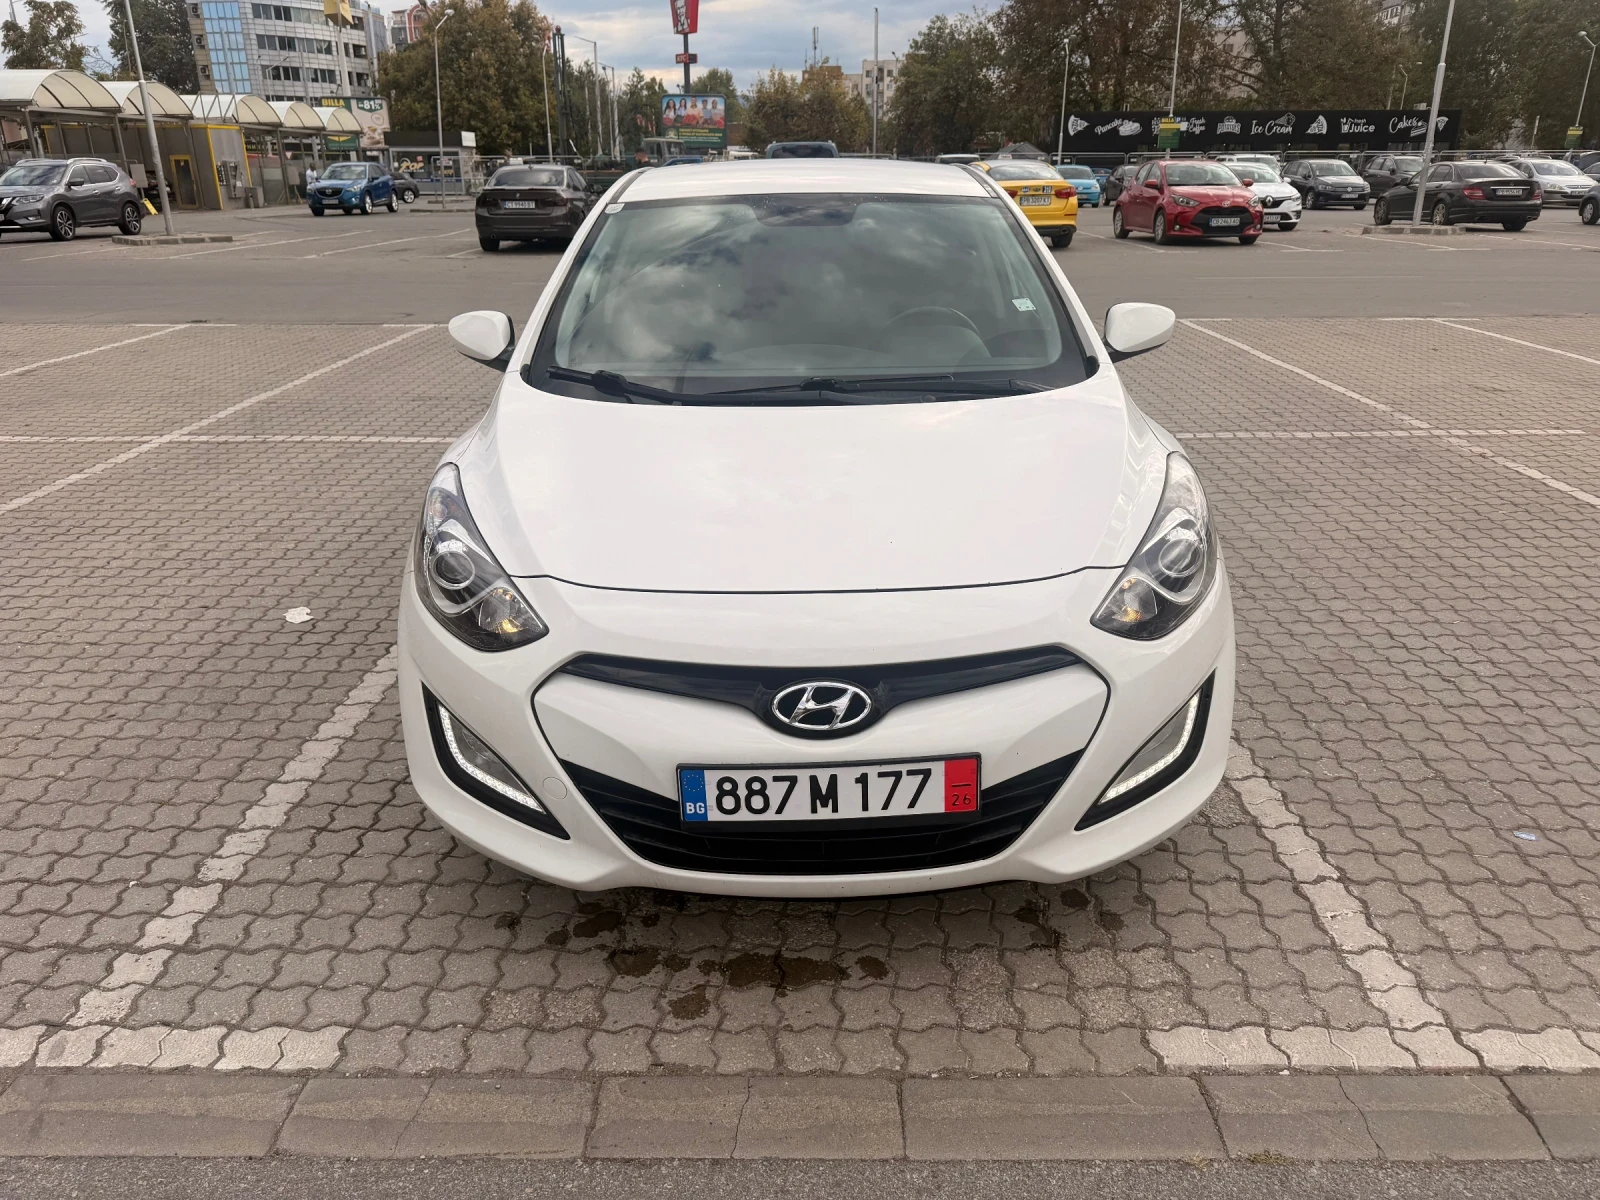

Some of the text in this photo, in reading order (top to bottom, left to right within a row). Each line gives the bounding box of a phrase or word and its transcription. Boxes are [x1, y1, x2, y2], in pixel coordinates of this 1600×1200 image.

[321, 98, 345, 107] BILLA
[1095, 118, 1123, 135] Pancake
[1250, 120, 1293, 136] Ice Cream
[1349, 123, 1376, 132] Juice
[399, 161, 425, 173] TOP
[715, 768, 932, 815] 887 M 177
[951, 793, 972, 806] 26
[686, 802, 705, 814] BG
